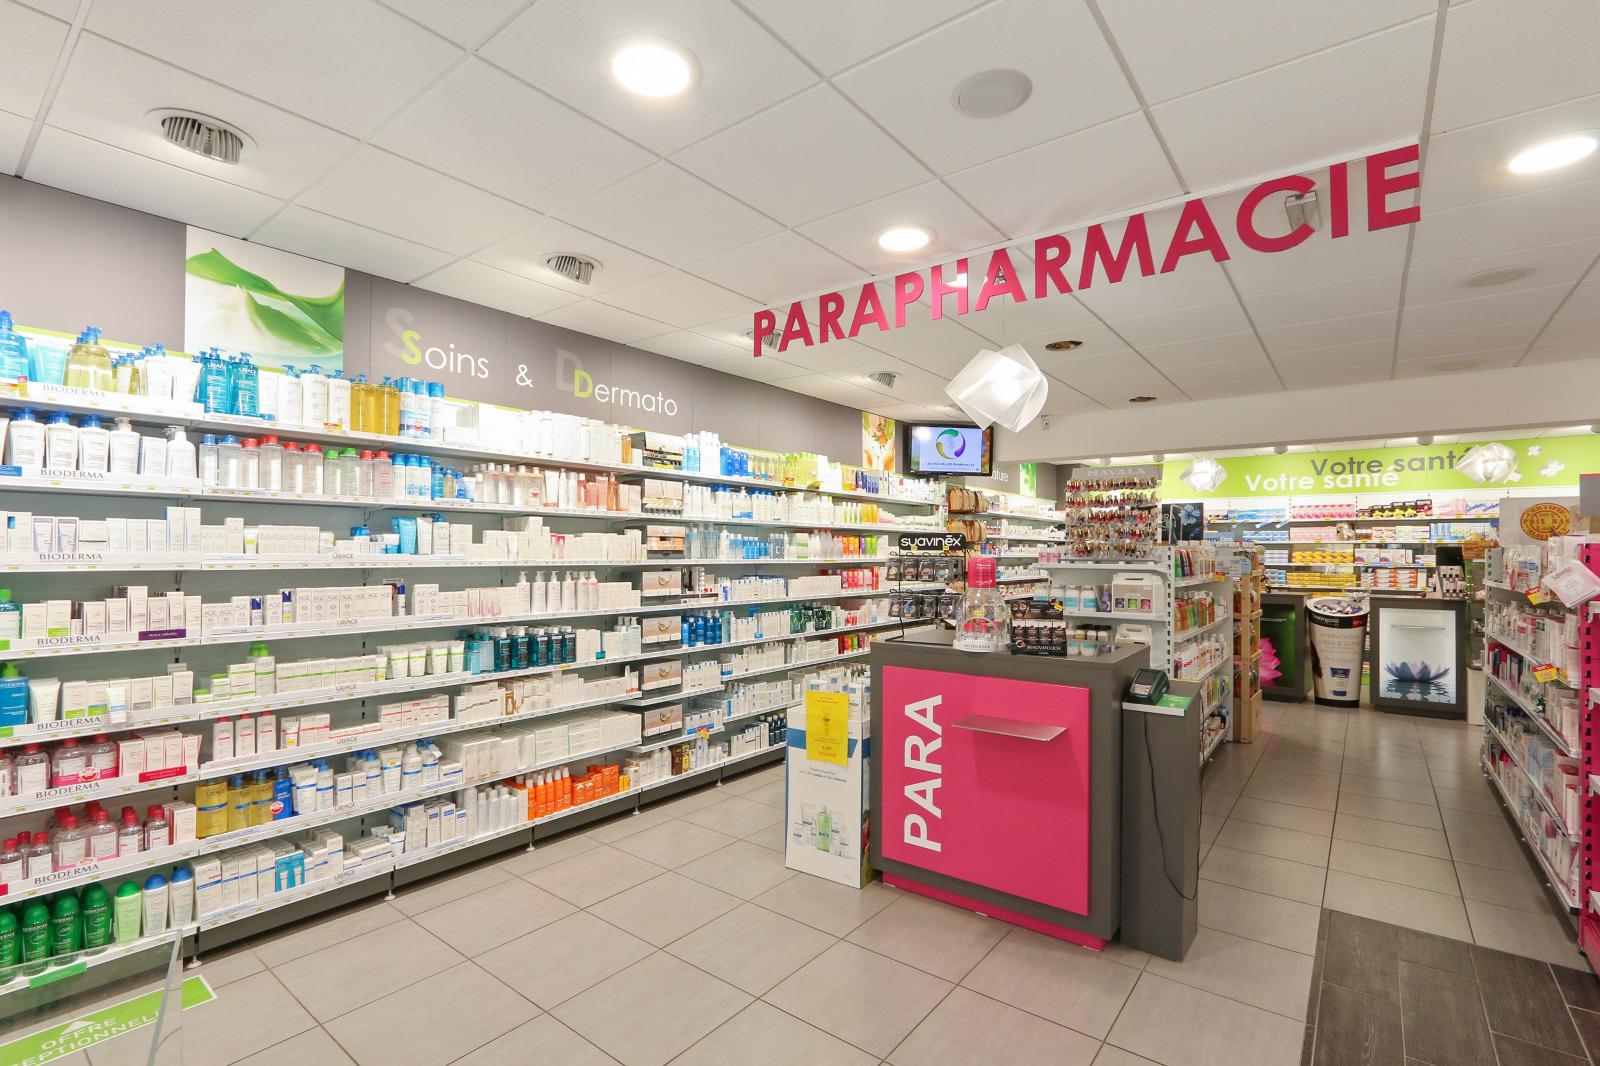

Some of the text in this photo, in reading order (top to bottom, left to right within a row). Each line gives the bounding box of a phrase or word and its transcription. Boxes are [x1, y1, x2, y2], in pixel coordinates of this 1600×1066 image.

[753, 143, 1421, 358] PARAPHARMACIE
[401, 329, 678, 416] Soins & Dermato
[40, 468, 105, 479] BIODERMA
[1311, 447, 1473, 477] Votre sant
[1245, 464, 1400, 493] Votre santé
[39, 552, 103, 561] BIODERMA
[37, 634, 101, 647] BIODERMA
[37, 715, 101, 731] BIODERMA
[903, 694, 943, 853] PARA
[35, 781, 100, 799] BIODERMA
[34, 863, 99, 885] BIODERMA
[41, 1017, 119, 1051] OFFRE
